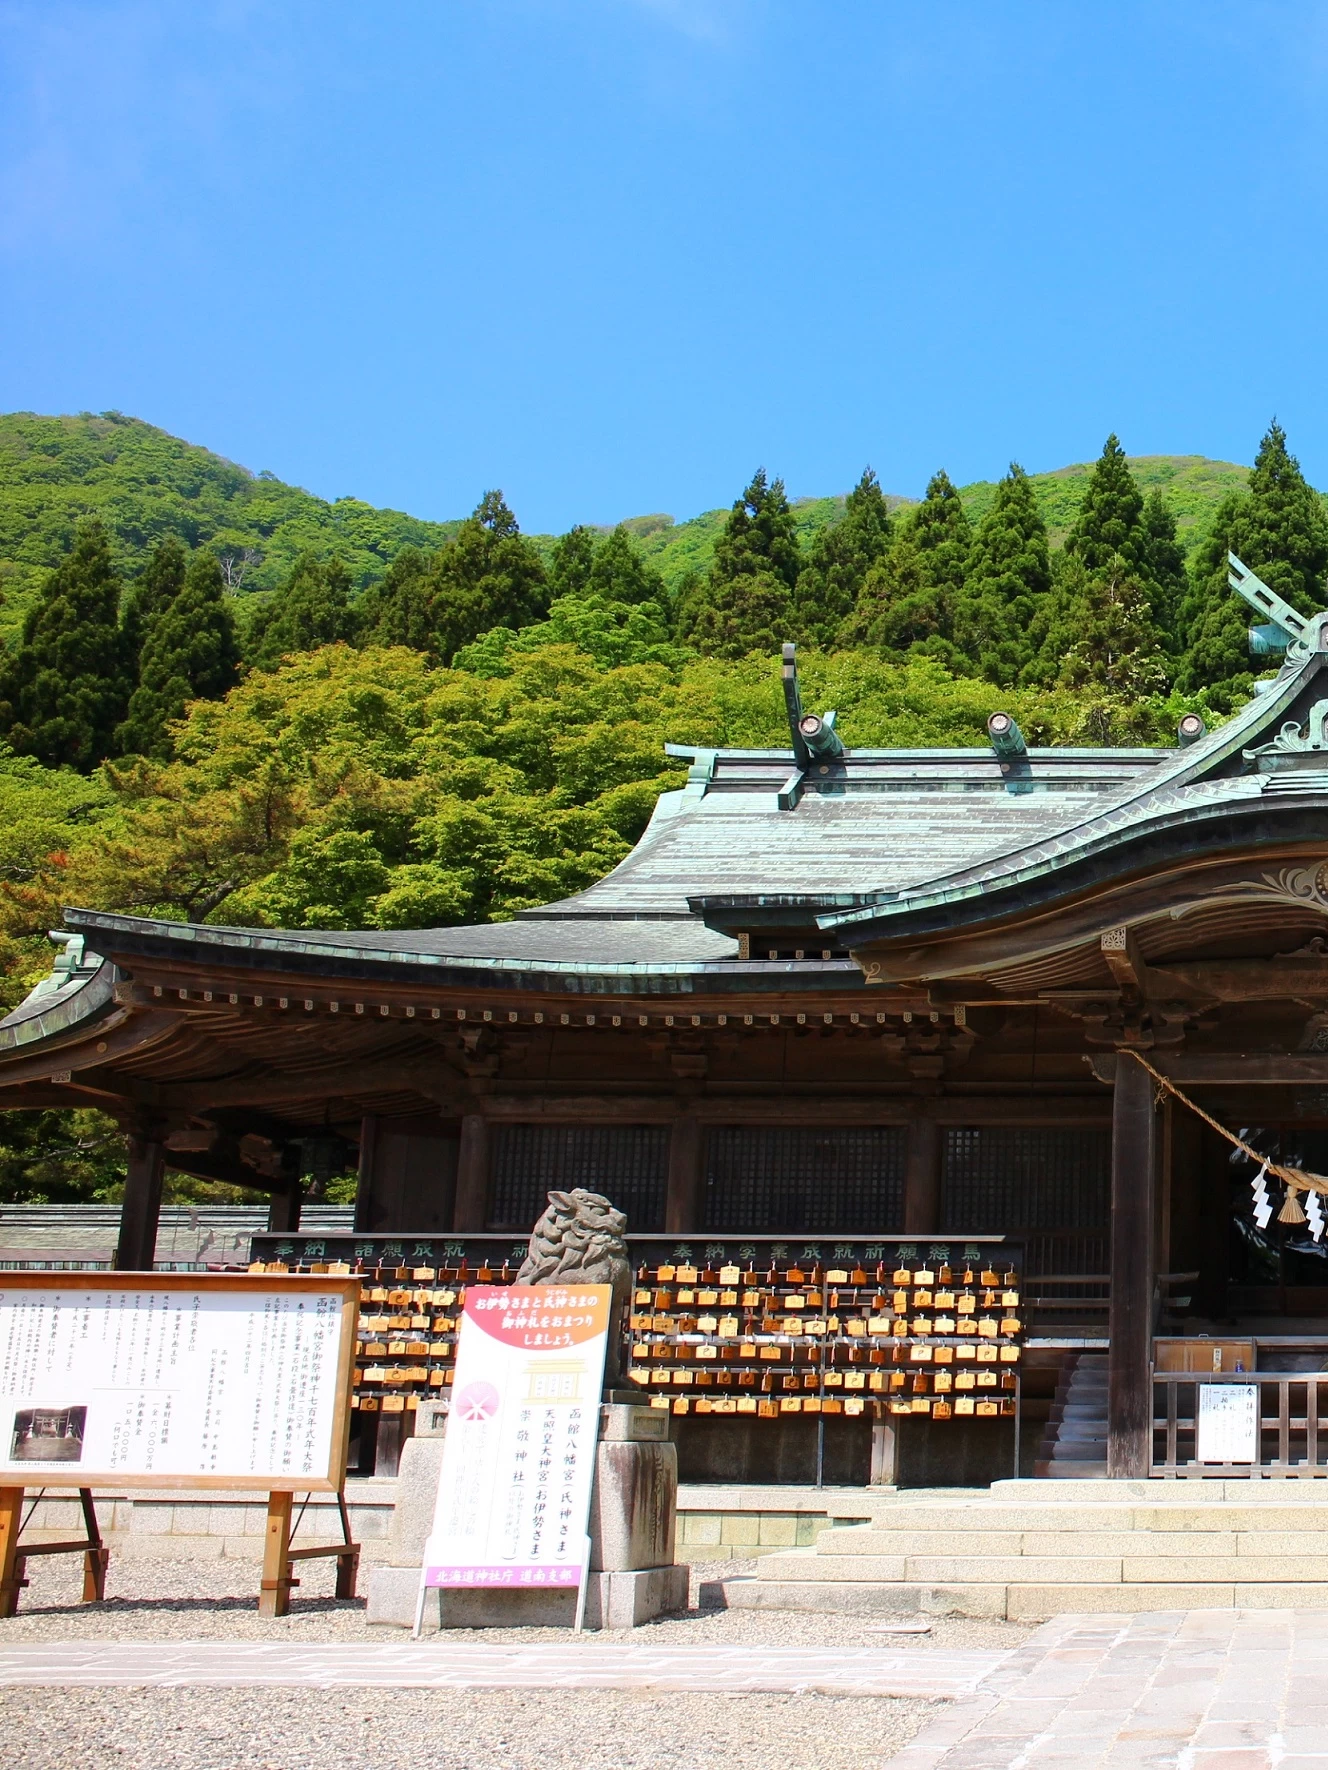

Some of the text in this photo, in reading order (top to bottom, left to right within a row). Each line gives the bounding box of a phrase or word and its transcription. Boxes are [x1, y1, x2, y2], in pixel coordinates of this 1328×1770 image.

[274, 1240, 326, 1258] 奉納
[354, 1239, 465, 1258] 諸願成就
[672, 1243, 981, 1260] 奉納学業成就祈願絵馬
[475, 1296, 598, 1310] お伊勢さまと氏神さまの
[502, 1315, 594, 1329] 御神札をおまつり
[524, 1333, 574, 1346] しましょう。
[528, 1408, 556, 1561] 天照皇大神宮（お伊勢さま）
[554, 1408, 582, 1561] 函館八幡宮（氏神さま）
[436, 1569, 573, 1584] 北海道神社庁 道南支部
